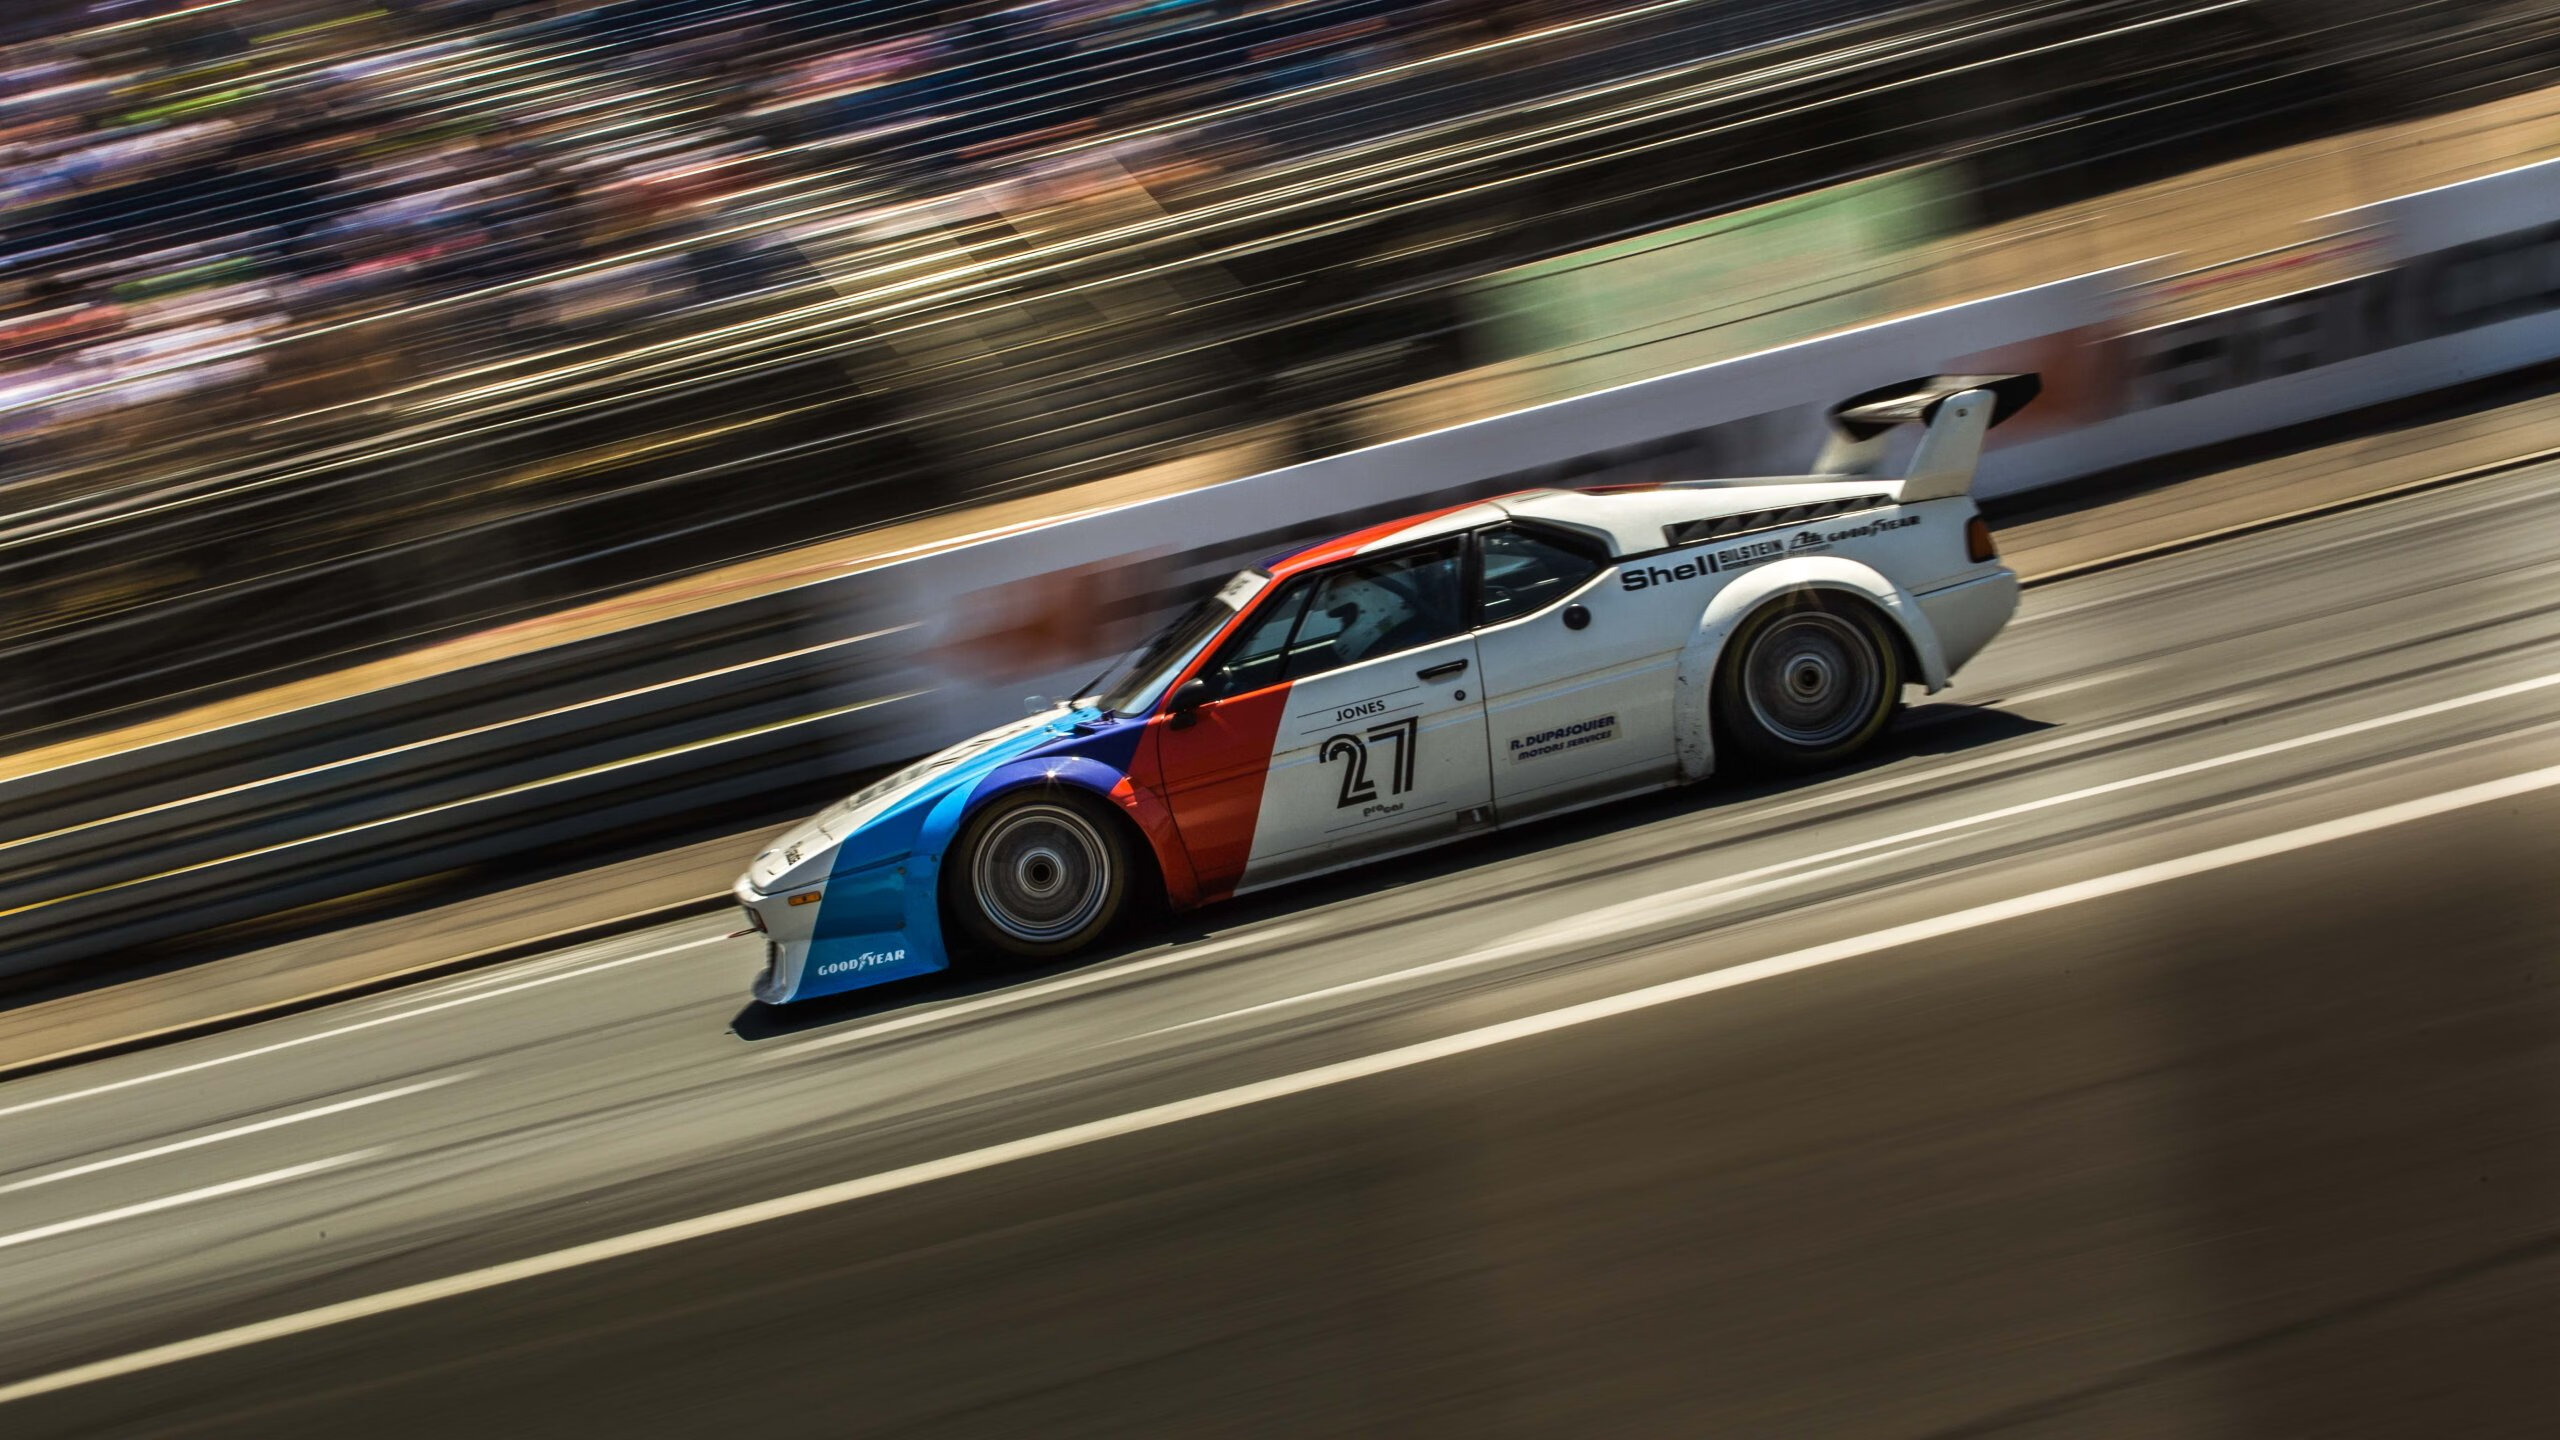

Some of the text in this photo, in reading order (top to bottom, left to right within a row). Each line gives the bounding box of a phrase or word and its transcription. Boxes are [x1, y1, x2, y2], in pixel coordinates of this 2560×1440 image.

[1828, 515, 1921, 542] GOODYEAR
[1720, 538, 1785, 564] BILSTEIN
[1621, 553, 1718, 592] Shell
[1336, 700, 1386, 722] JONES
[1518, 730, 1613, 761] MOTORS SERVICES
[1526, 715, 1615, 747] DUPASQUIER
[1319, 716, 1419, 809] 27
[818, 949, 905, 976] GOODYEAR
